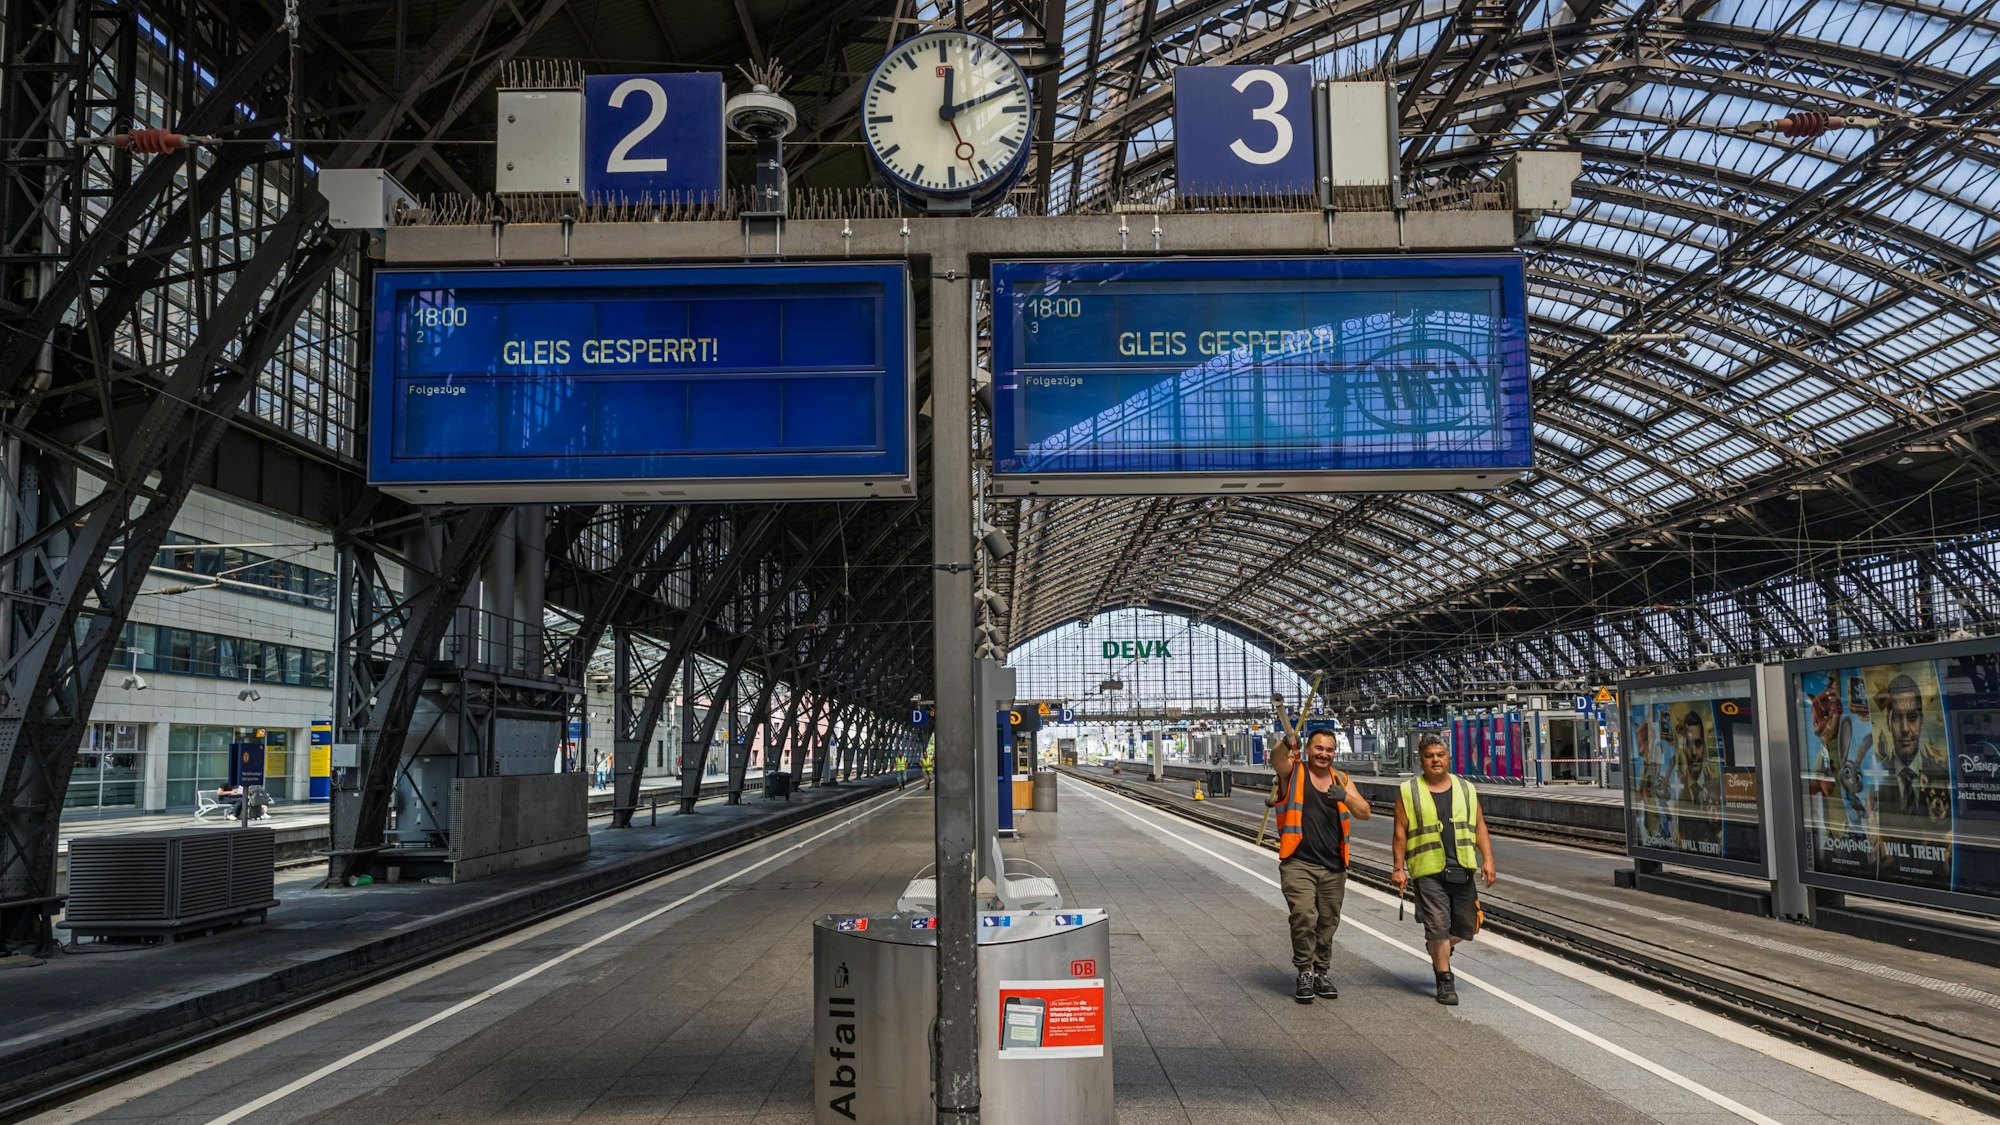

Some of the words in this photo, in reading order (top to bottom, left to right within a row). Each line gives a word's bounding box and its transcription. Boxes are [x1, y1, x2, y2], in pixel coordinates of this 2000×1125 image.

[1229, 69, 1294, 165] 3
[606, 78, 668, 173] 2
[1027, 298, 1081, 318] 18:00
[413, 306, 467, 328] 18:00
[1031, 322, 1039, 334] 3
[416, 331, 424, 343] 2
[1119, 331, 1186, 356] GLEIS
[1199, 330, 1334, 355] GESPERRT!
[503, 340, 570, 364] GLEIS
[583, 338, 718, 363] GESPERRT!
[1026, 375, 1083, 387] Folgezüge
[409, 384, 466, 396] Folgezüge
[1103, 640, 1172, 660] DEVK
[1576, 697, 1587, 709] D
[913, 711, 922, 723] D
[1063, 709, 1073, 722] D
[1957, 791, 1976, 800] Jetzt
[1681, 839, 1698, 851] WILL
[1698, 841, 1719, 854] TRENT
[1820, 837, 1873, 853] ZOOMANIA
[1883, 842, 1910, 858] WILL
[1911, 844, 1947, 862] TRENT
[1073, 962, 1094, 977] DB
[829, 997, 856, 1121] Abfall
